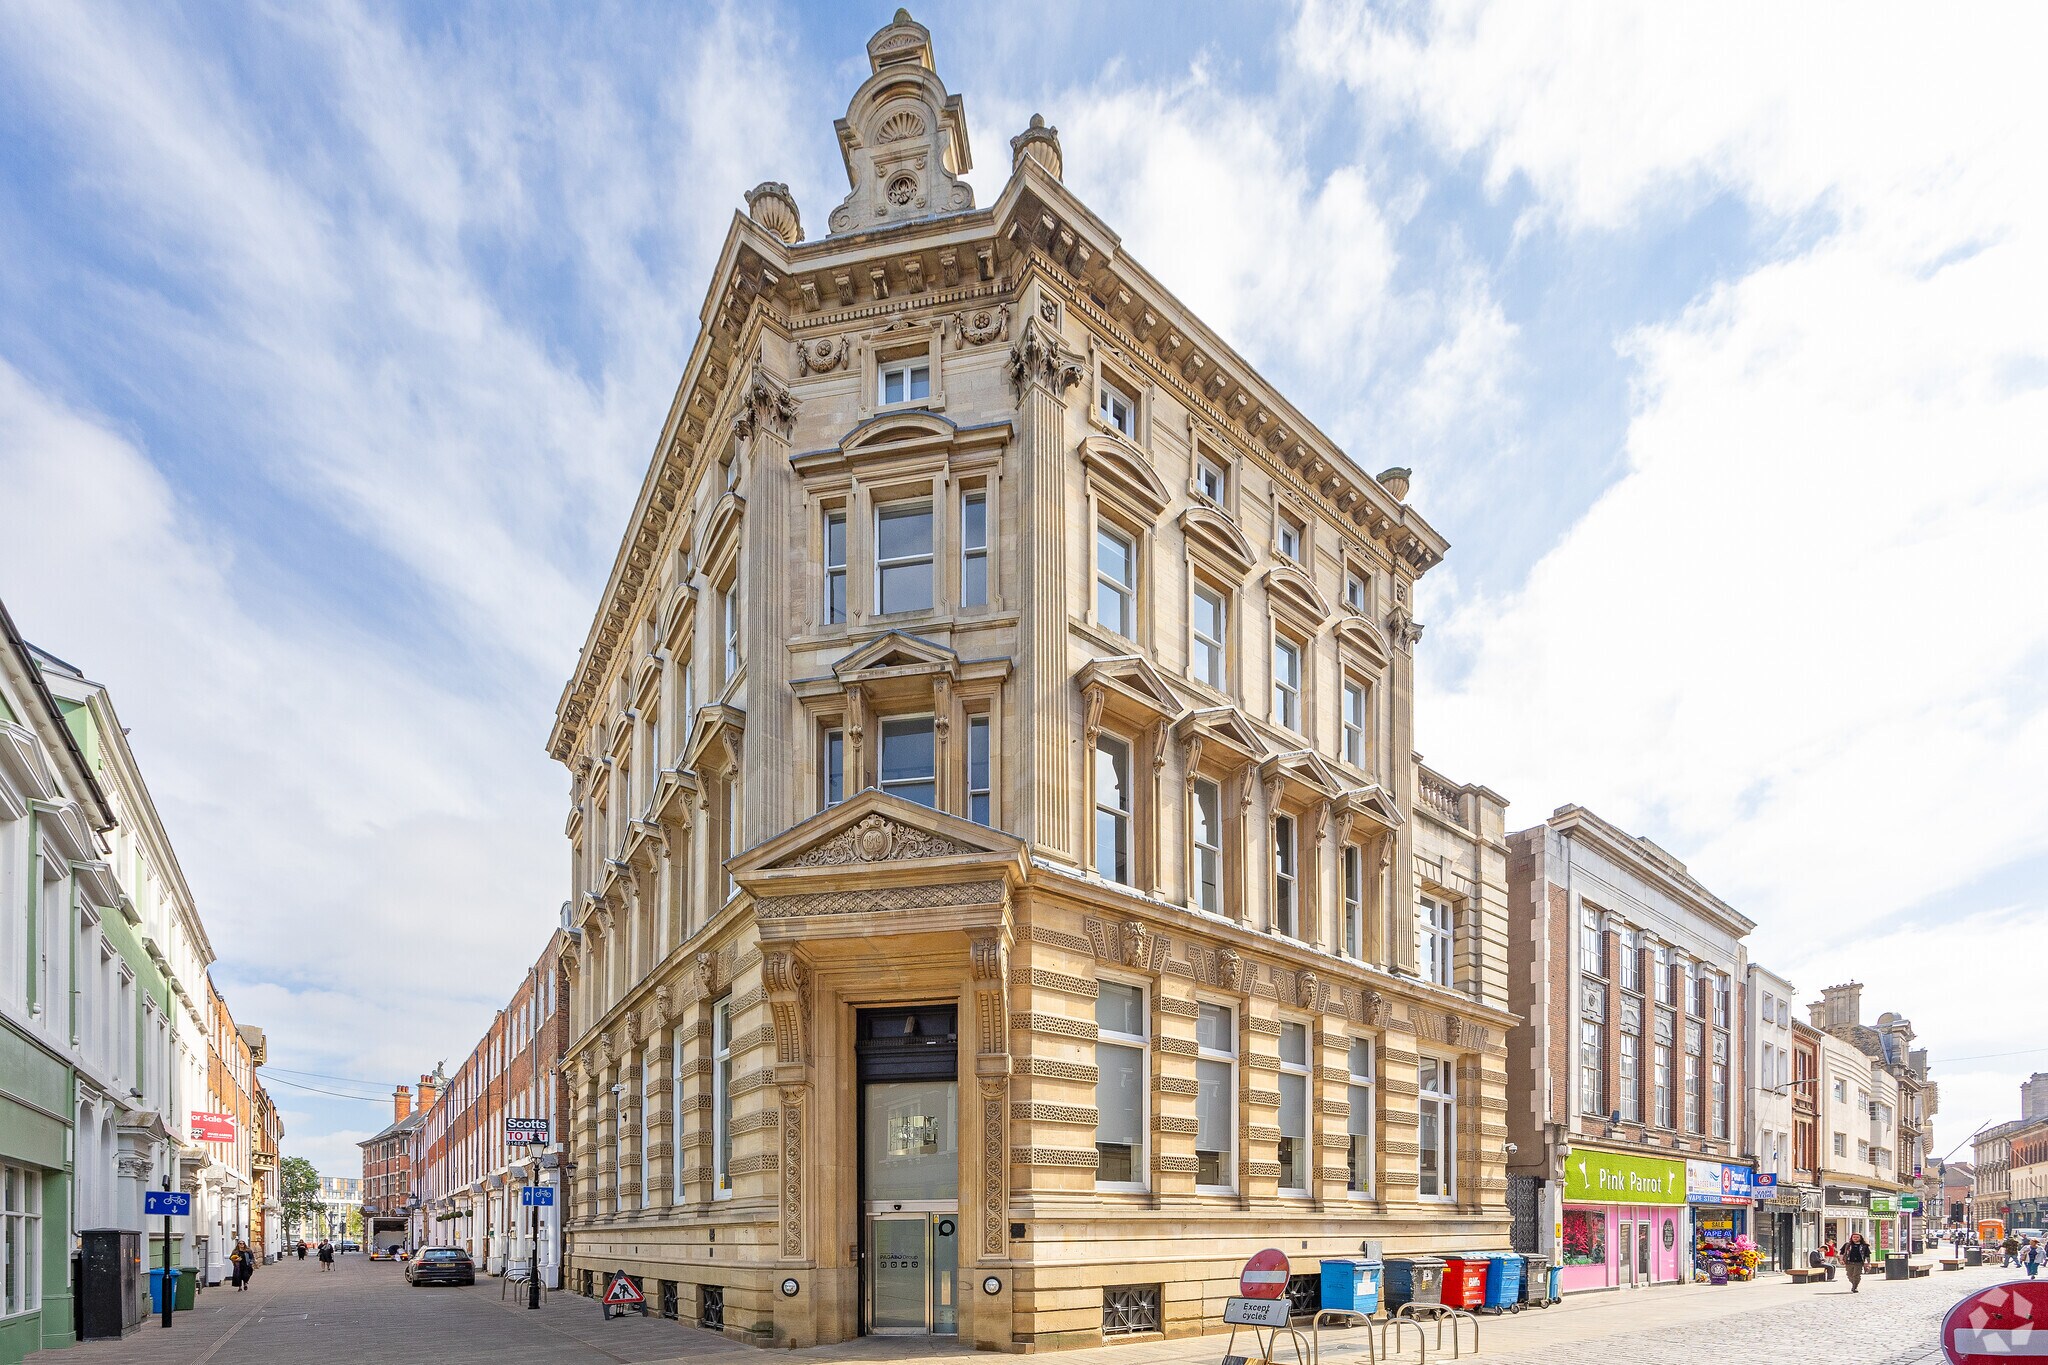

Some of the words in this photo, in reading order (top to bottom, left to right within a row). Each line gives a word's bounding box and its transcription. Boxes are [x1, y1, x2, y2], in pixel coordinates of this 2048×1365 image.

[508, 1119, 547, 1128] Scotts
[507, 1132, 523, 1140] TO
[527, 1132, 547, 1140] LT
[1600, 1168, 1625, 1190] Pink
[1630, 1171, 1662, 1193] Parrot
[1243, 1303, 1271, 1313] Except
[1242, 1312, 1268, 1320] cycles
